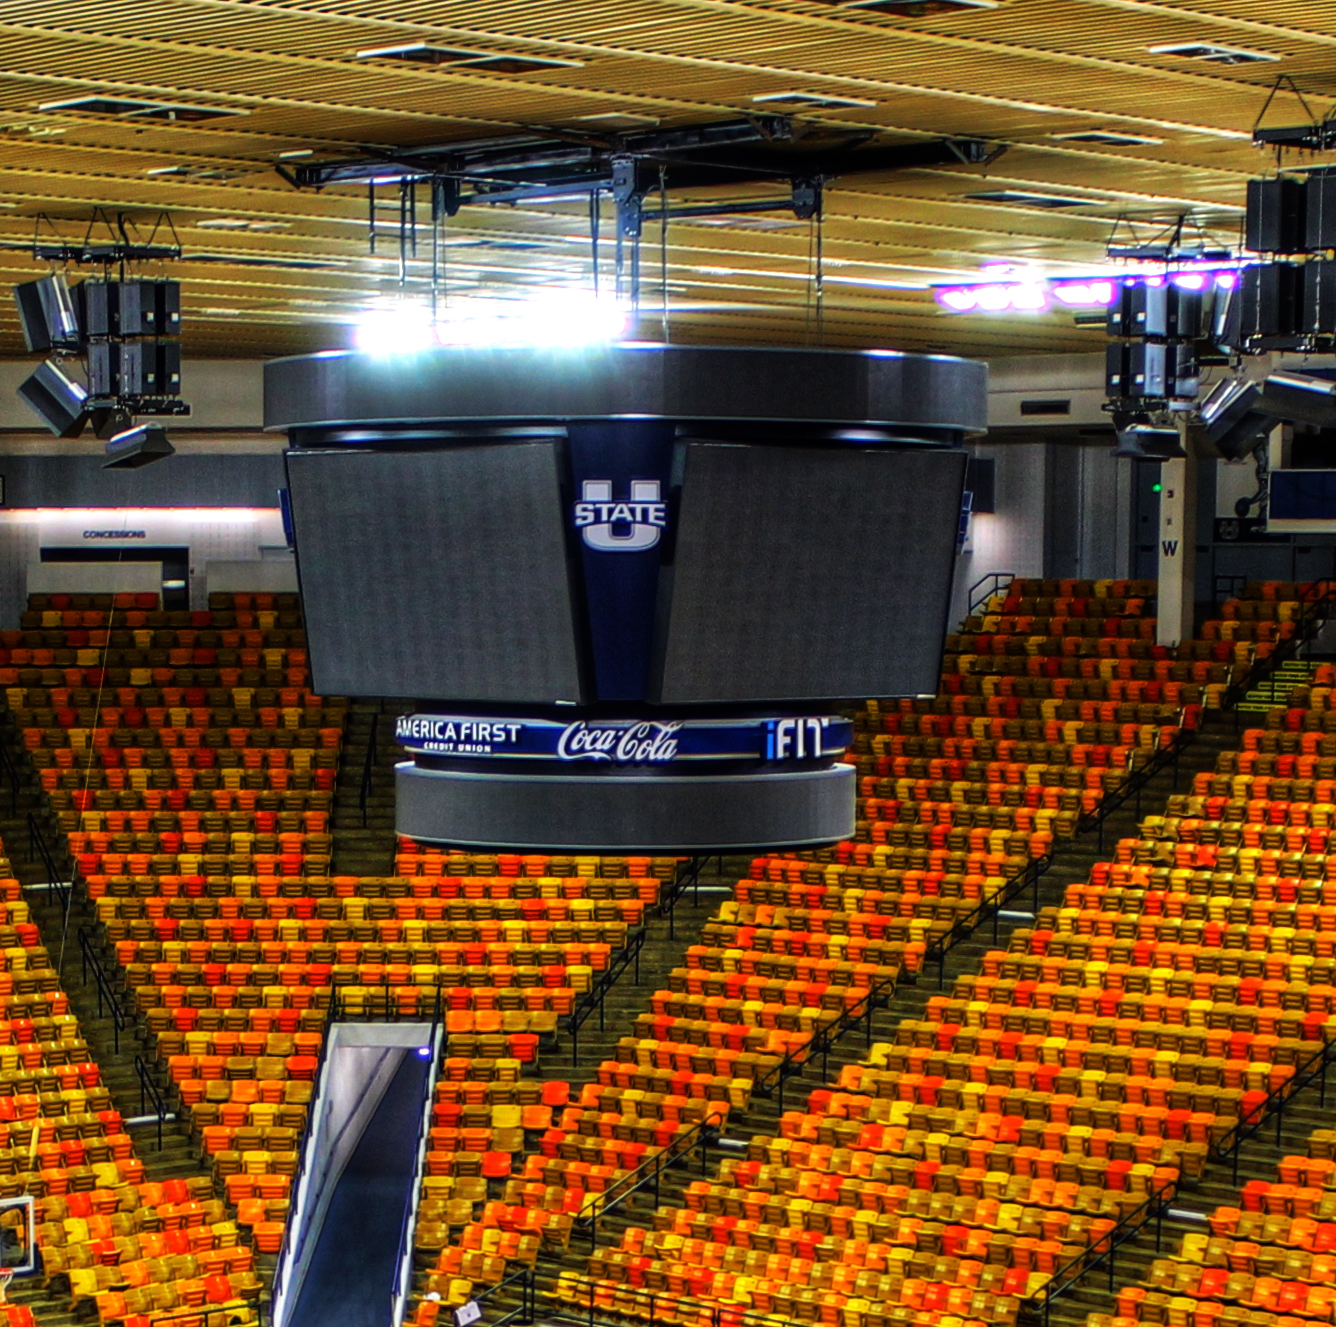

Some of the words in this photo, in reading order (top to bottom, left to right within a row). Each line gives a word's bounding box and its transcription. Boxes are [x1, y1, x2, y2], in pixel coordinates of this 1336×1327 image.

[574, 503, 666, 528] STATE
[83, 530, 147, 539] CONCESSIONS
[1162, 540, 1178, 557] W
[395, 718, 457, 742] AMERICA
[460, 721, 523, 743] FIRST
[557, 720, 684, 762] Coca-Cola
[423, 741, 455, 751] CREDIT
[458, 743, 492, 753] UNION
